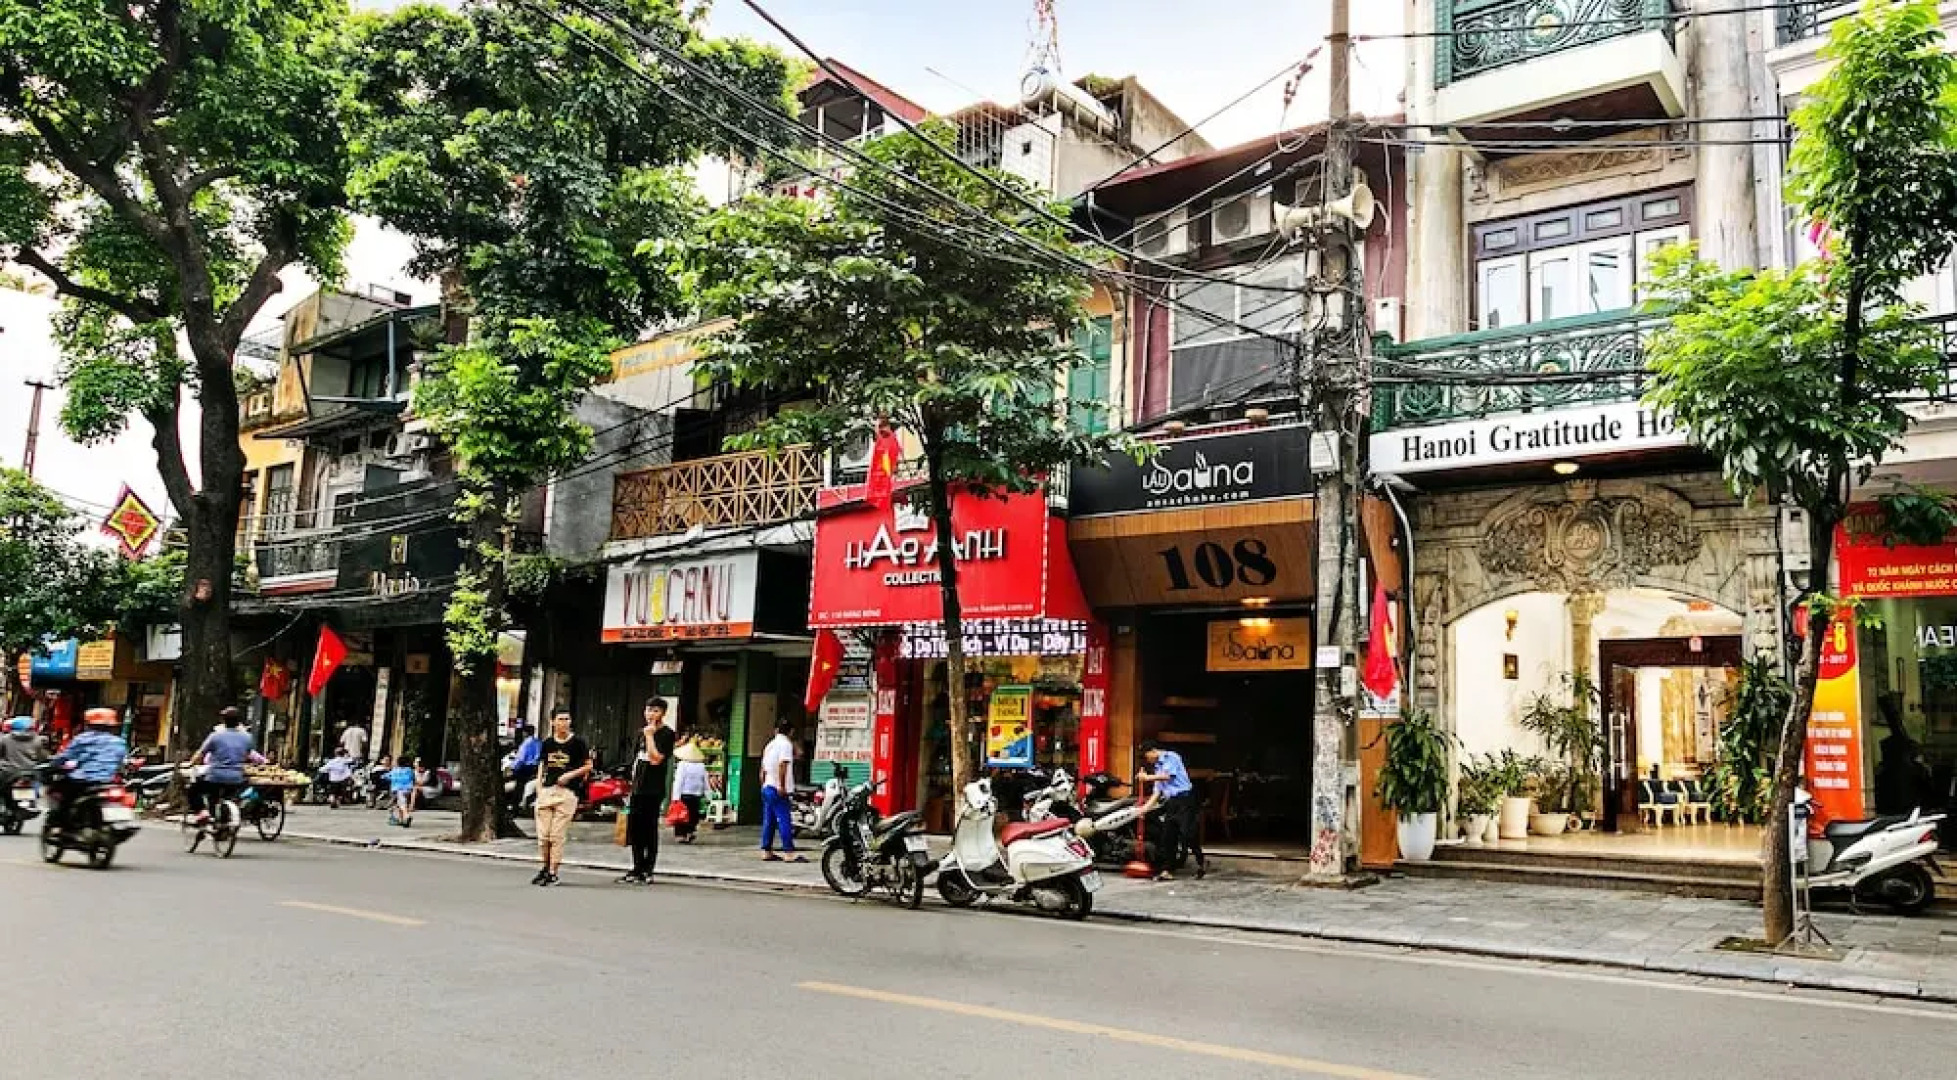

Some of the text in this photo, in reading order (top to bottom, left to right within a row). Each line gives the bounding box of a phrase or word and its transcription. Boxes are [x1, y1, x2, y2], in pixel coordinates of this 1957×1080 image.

[1402, 429, 1477, 462] Hanoi
[1490, 414, 1622, 452] Gratitude
[1157, 538, 1277, 591] 108
